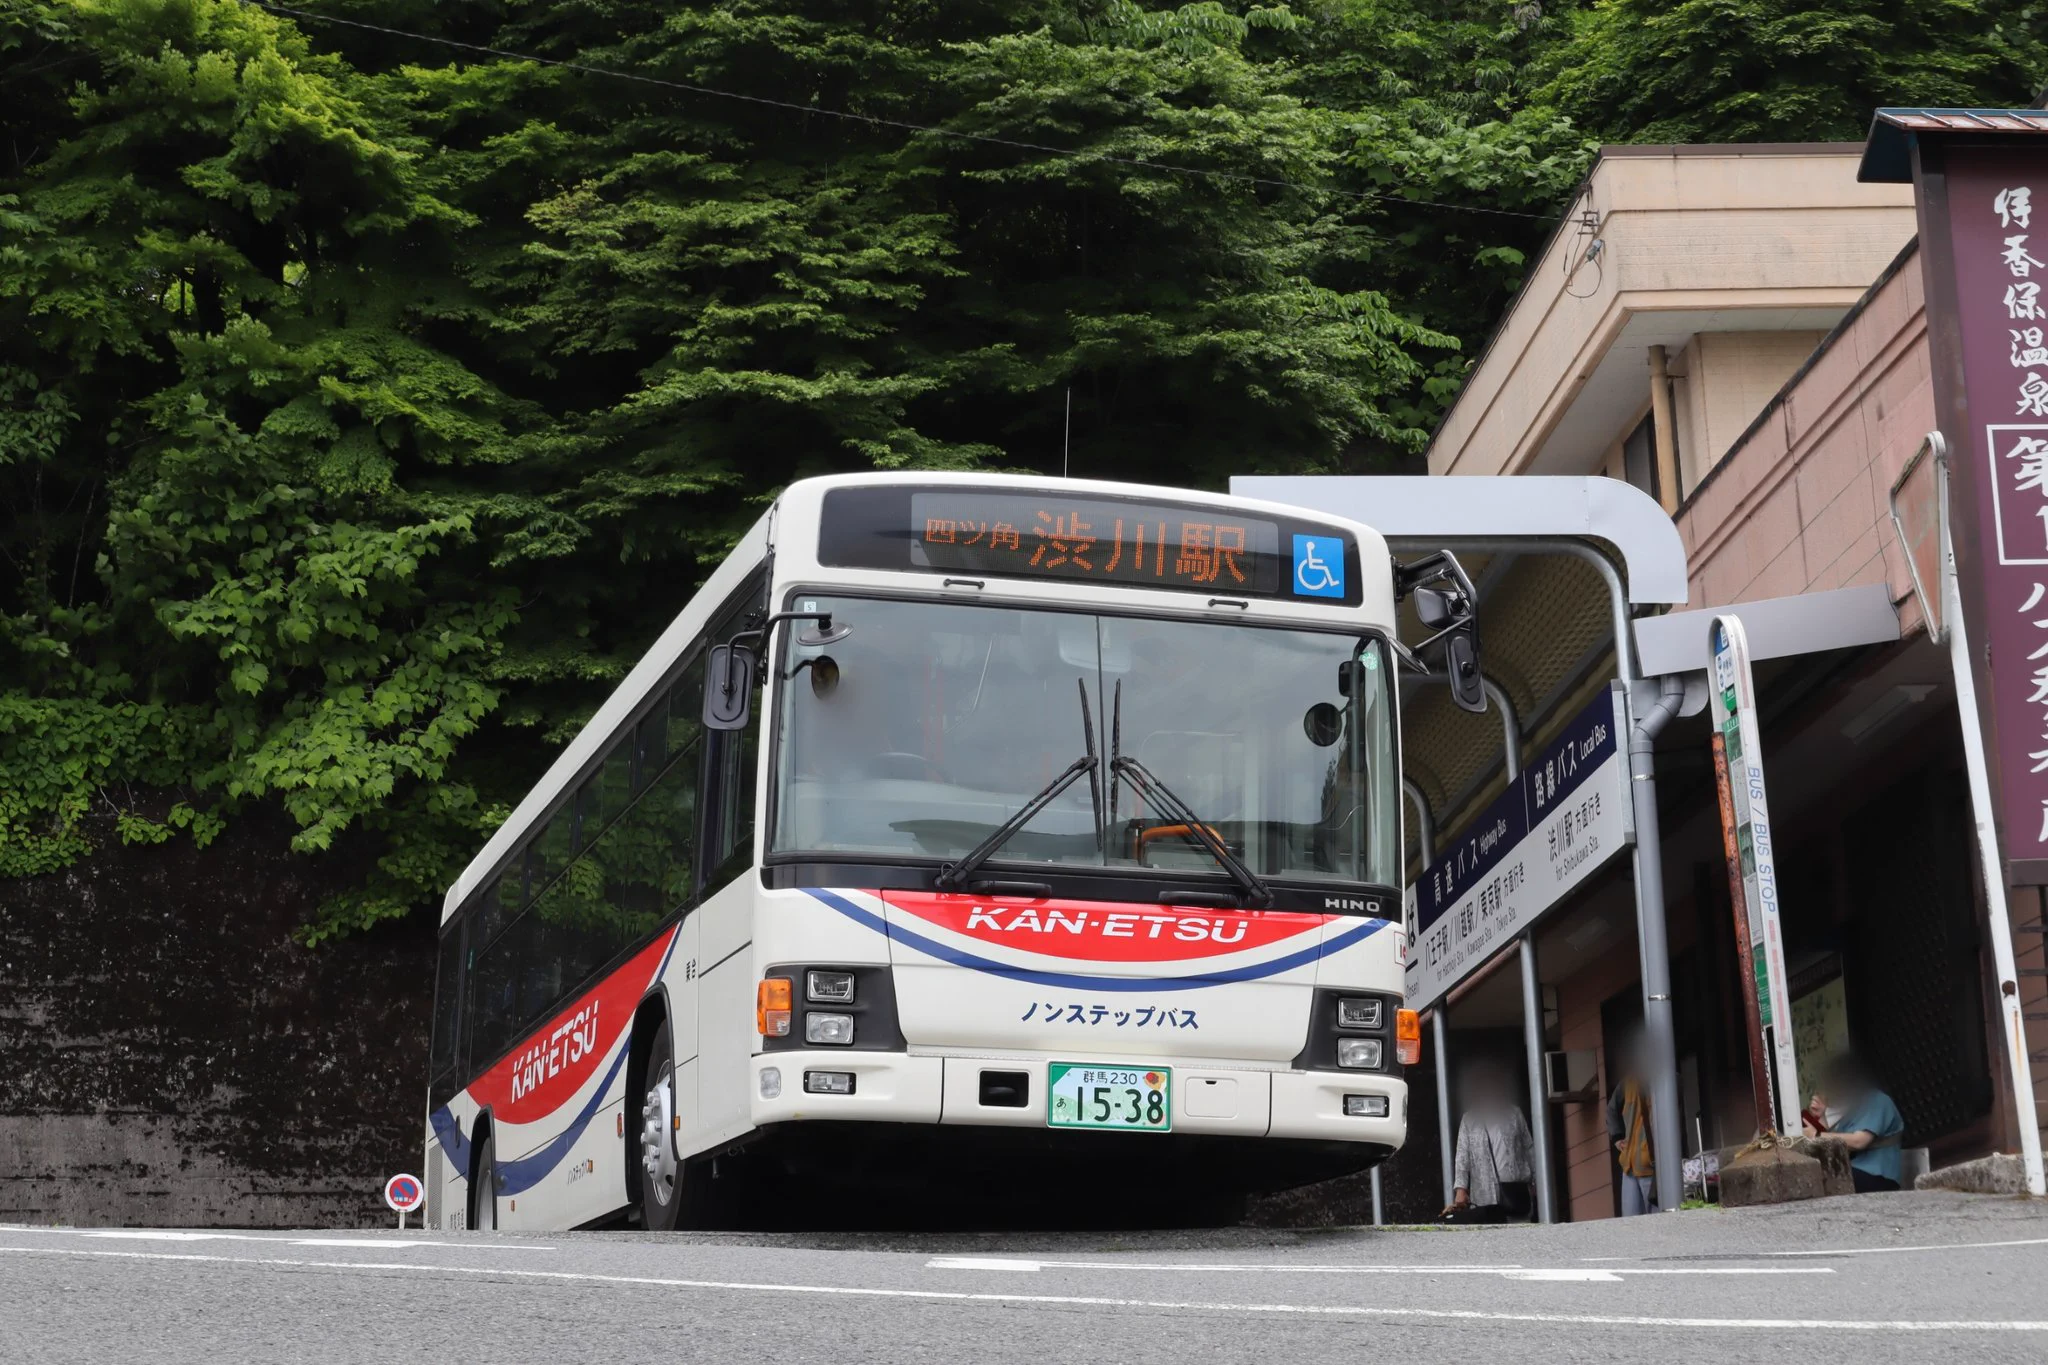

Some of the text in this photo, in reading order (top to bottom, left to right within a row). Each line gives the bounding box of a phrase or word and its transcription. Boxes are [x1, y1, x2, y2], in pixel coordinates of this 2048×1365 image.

[926, 511, 1245, 582] 四ツ角 渋川駅
[1534, 723, 1607, 809] 路線バス Local Bus
[1747, 767, 1763, 800] BUS
[1547, 791, 1601, 862] 渋川駅 方面行き
[1754, 823, 1770, 856] BUS
[1433, 818, 1507, 907] 高速バス Highway Bus
[1555, 864, 1563, 882] for
[1563, 844, 1589, 876] Shibukawa
[1325, 898, 1380, 913] HINO
[1759, 864, 1776, 913] STOP
[1495, 912, 1509, 935] Tokyo
[1021, 1002, 1199, 1030] ノンステップバス
[1056, 1097, 1067, 1109] あ
[1077, 1086, 1164, 1124] 15-38
